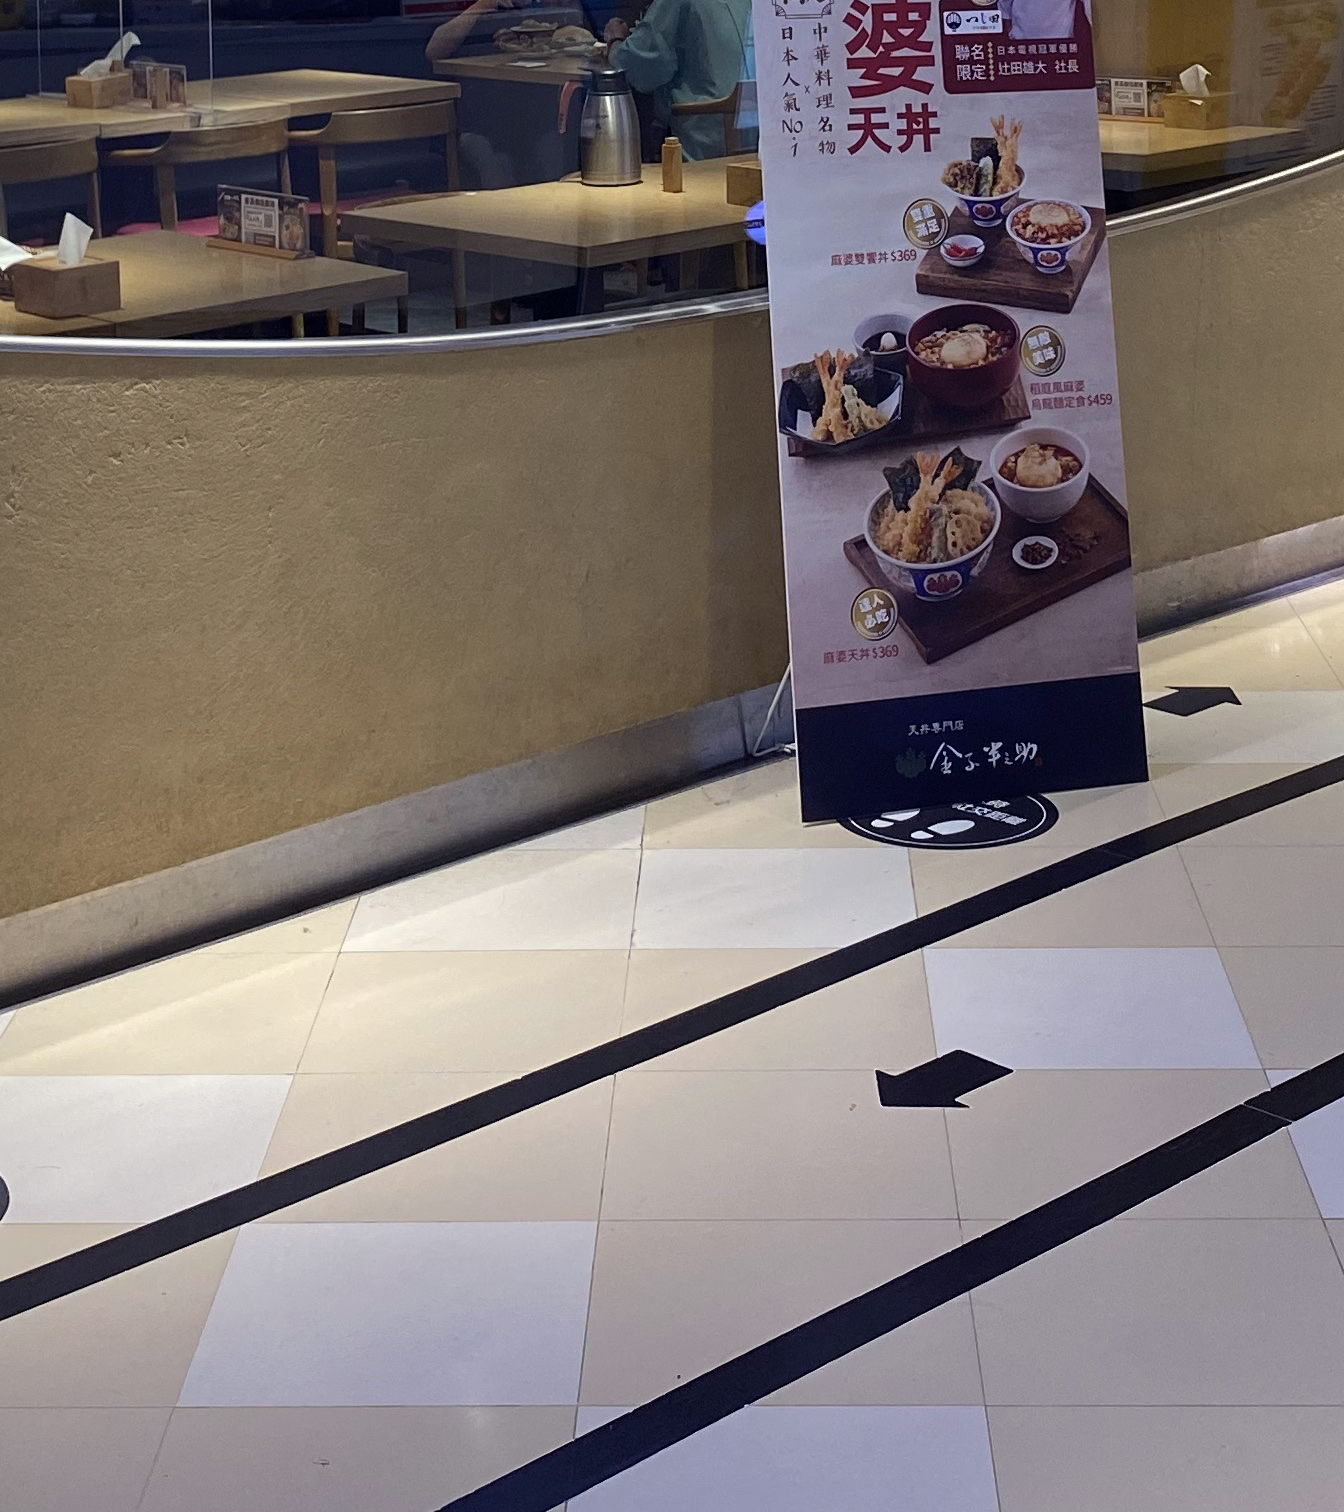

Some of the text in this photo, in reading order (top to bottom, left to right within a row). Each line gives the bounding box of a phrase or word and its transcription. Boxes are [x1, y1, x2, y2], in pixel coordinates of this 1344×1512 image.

[954, 43, 985, 61] 聯名
[956, 63, 987, 81] 限定
[1054, 58, 1079, 74] 社長
[813, 22, 836, 155] 中華料理名物
[847, 104, 941, 155] 天丼
[929, 742, 1038, 775] 金子半之助
